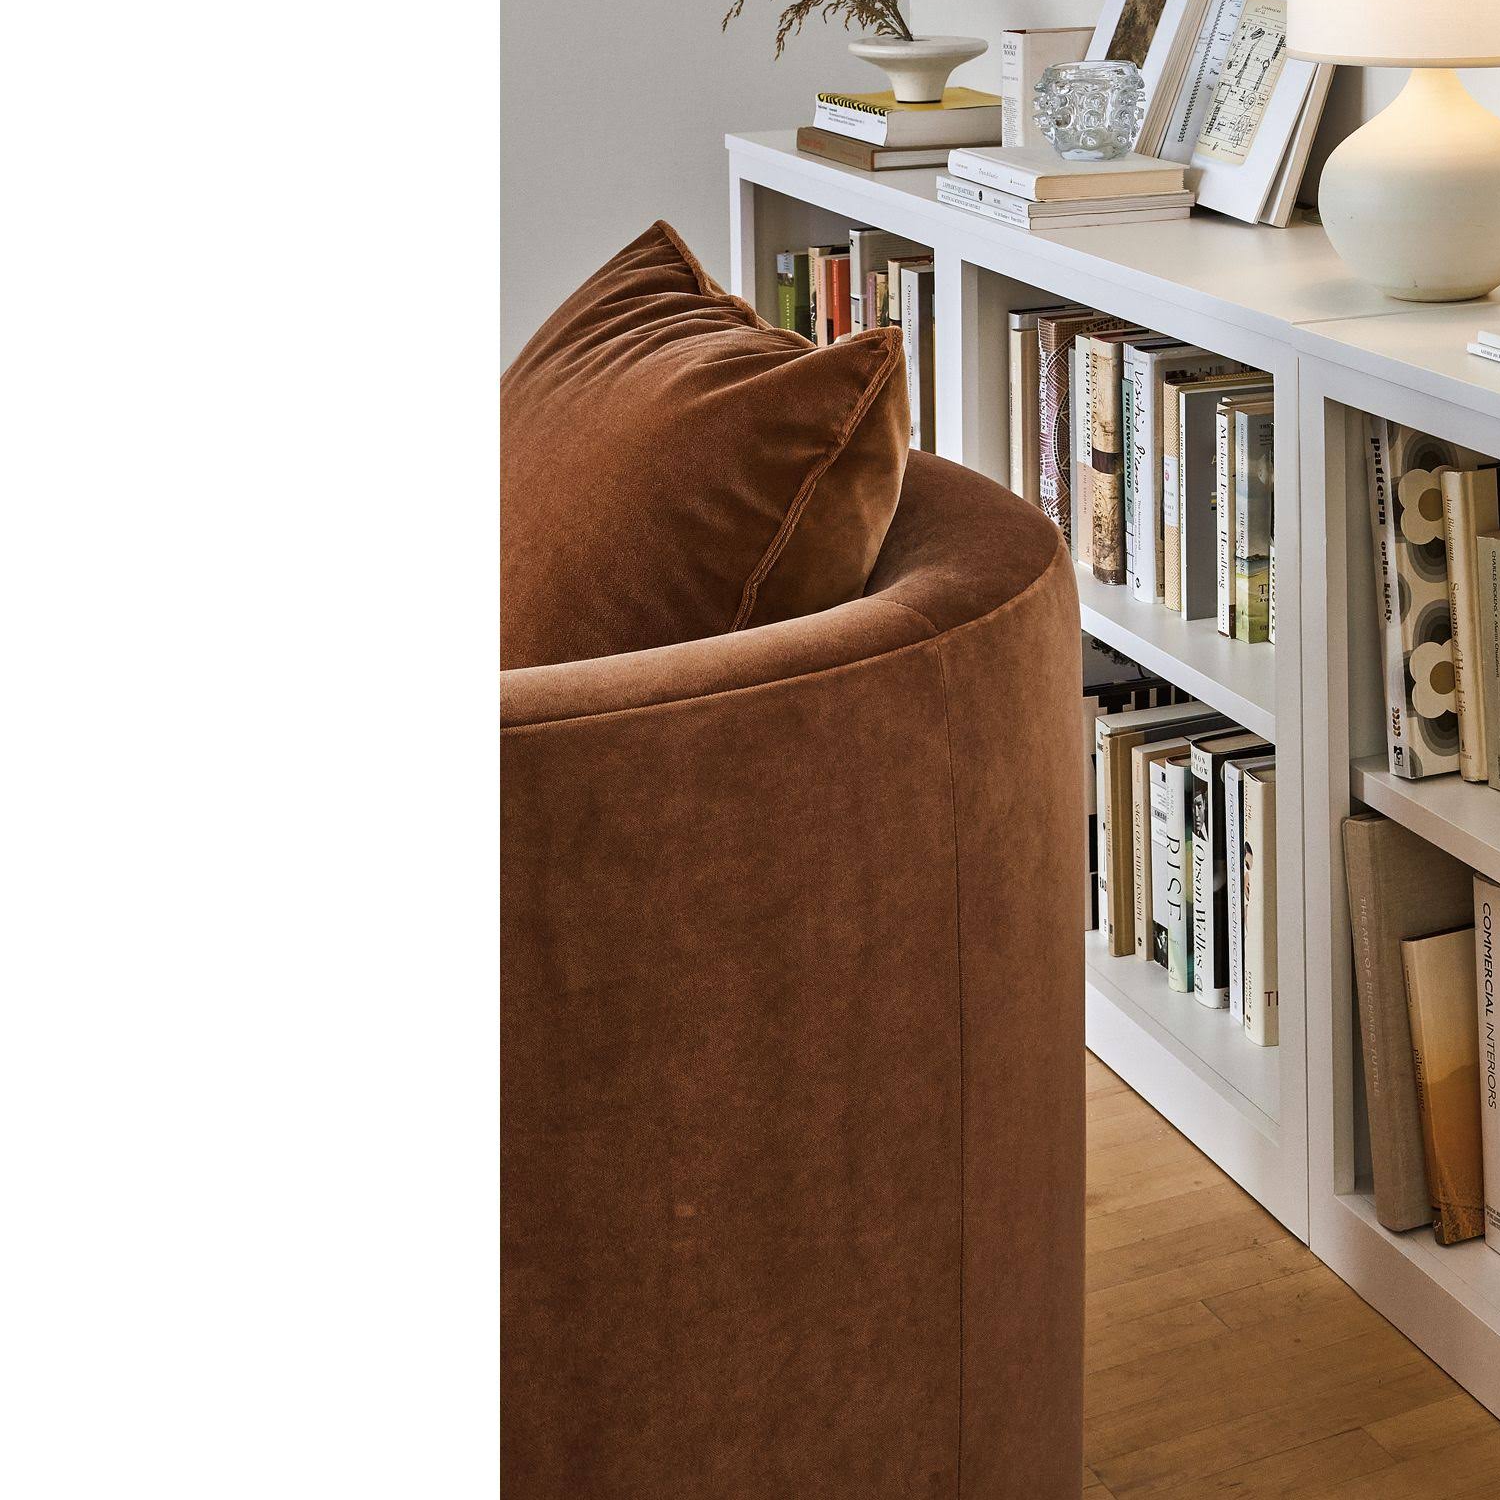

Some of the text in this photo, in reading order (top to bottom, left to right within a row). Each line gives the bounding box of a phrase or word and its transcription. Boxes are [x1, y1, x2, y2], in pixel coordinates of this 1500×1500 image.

[1125, 416, 1133, 490] NEWSSTAND
[1219, 424, 1227, 478] Michael
[1370, 437, 1386, 526] pattern
[1218, 530, 1228, 590] Headlong
[1380, 540, 1393, 624] orla kiely
[1450, 581, 1460, 638] Seasons
[1454, 657, 1465, 687] Her
[1194, 843, 1207, 970] Orson Welles
[1359, 896, 1367, 928] THE
[1361, 930, 1370, 955] ART
[1364, 957, 1372, 976] OF
[1482, 901, 1498, 1110] COMMERCIAL INTERIORS
